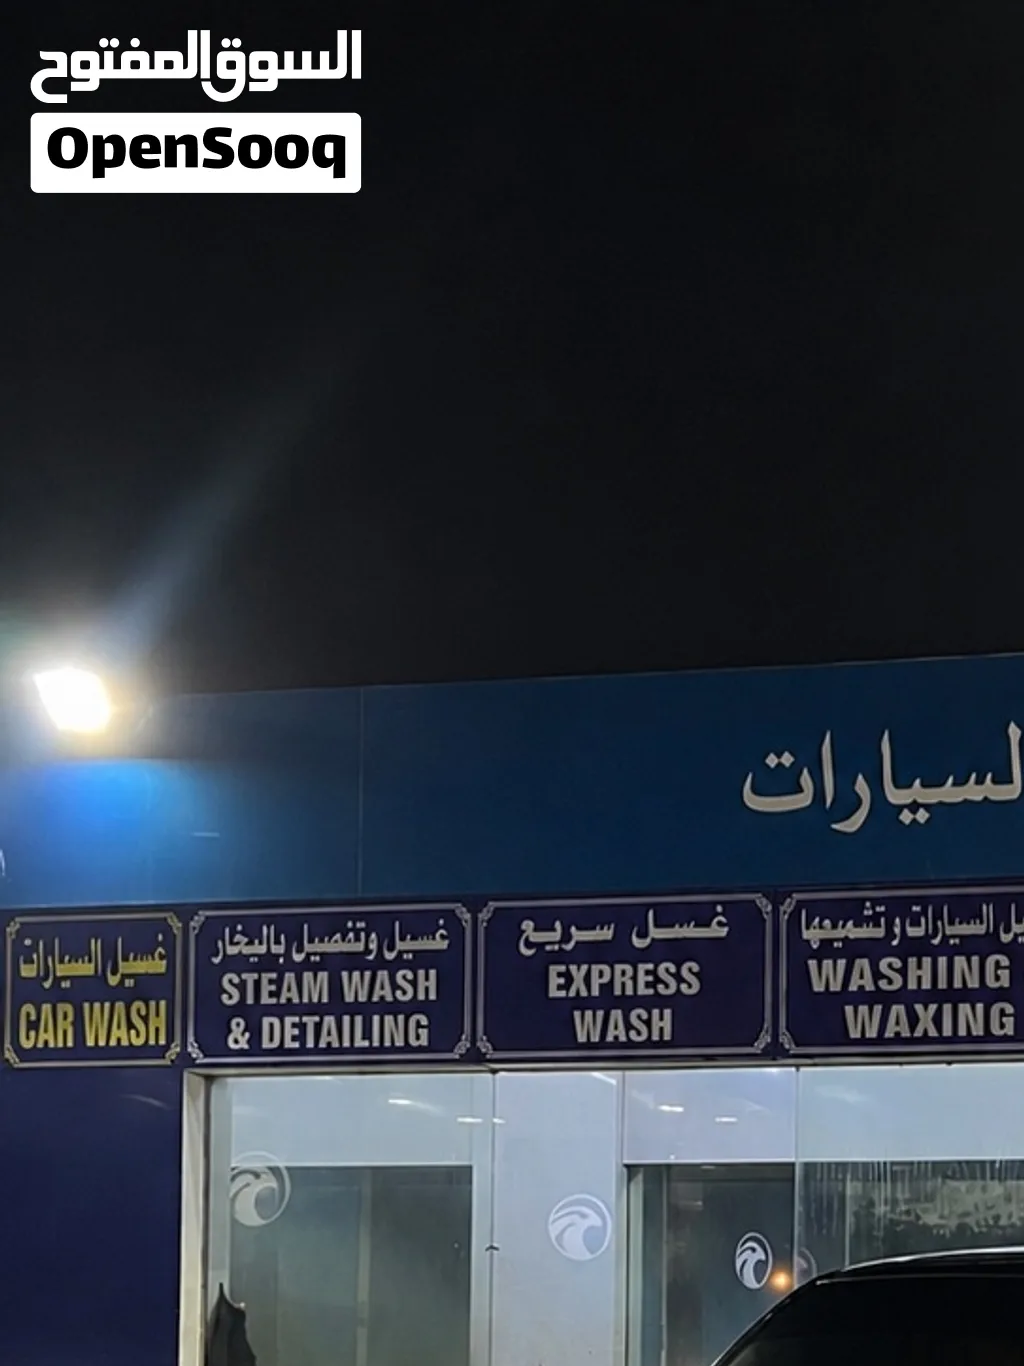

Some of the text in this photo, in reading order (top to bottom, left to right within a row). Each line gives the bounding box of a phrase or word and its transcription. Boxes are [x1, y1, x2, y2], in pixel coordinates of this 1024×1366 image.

[382, 918, 450, 961] غسيل
[518, 904, 730, 957] غسل سريع
[905, 902, 994, 945] السيارات
[18, 932, 167, 989] غسيل السيارات
[547, 960, 701, 999] EXPRESS
[806, 953, 1011, 993] WASHING
[220, 968, 438, 1006] STEAM WASH
[18, 999, 167, 1049] CAR WASH
[226, 1013, 430, 1050] & DETAILING
[572, 1007, 673, 1043] WASH
[843, 1001, 1015, 1039] WAXING
